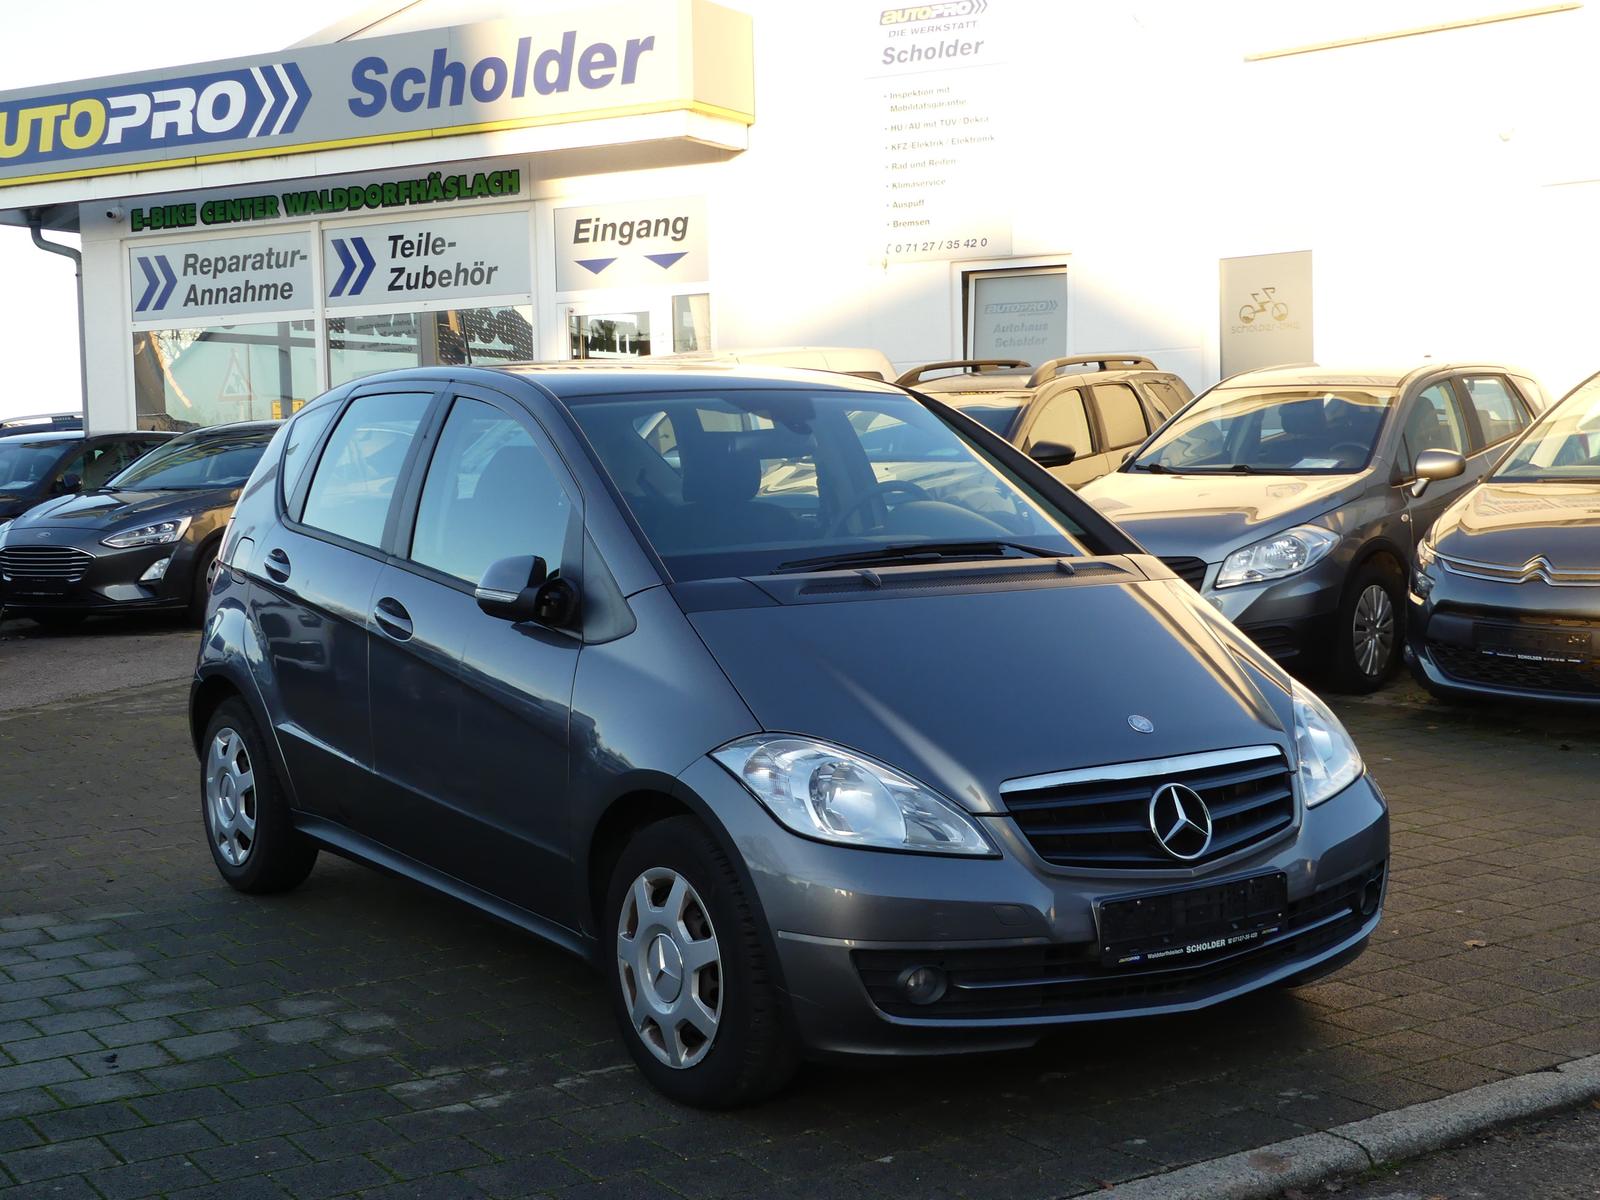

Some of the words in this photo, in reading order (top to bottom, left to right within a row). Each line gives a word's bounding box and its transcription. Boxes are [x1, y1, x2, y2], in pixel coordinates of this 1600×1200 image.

[888, 29, 907, 39] DIE
[910, 20, 978, 35] WERKSTATT
[881, 38, 985, 66] Scholder
[0, 79, 248, 159] UTOPRO
[347, 30, 656, 119] Scholder
[891, 161, 908, 171] Rad
[910, 160, 926, 169] und
[928, 158, 957, 167] Reifen
[891, 178, 946, 190] Klimaservice
[130, 203, 197, 233] E-BIKE
[200, 194, 280, 226] CENTER
[282, 169, 521, 217] WALDDORFHÄSLACH
[892, 199, 925, 210] Auspuff
[572, 215, 689, 246] Eingang
[892, 217, 931, 229] Bremsen
[387, 231, 457, 259] Teile-
[182, 247, 309, 279] Reparatur-
[387, 261, 499, 292] Zubehör
[182, 279, 294, 308] Annahme
[993, 322, 1049, 334] Autohaus
[993, 336, 1049, 348] Scholder
[1185, 939, 1227, 955] SCHOLDER
